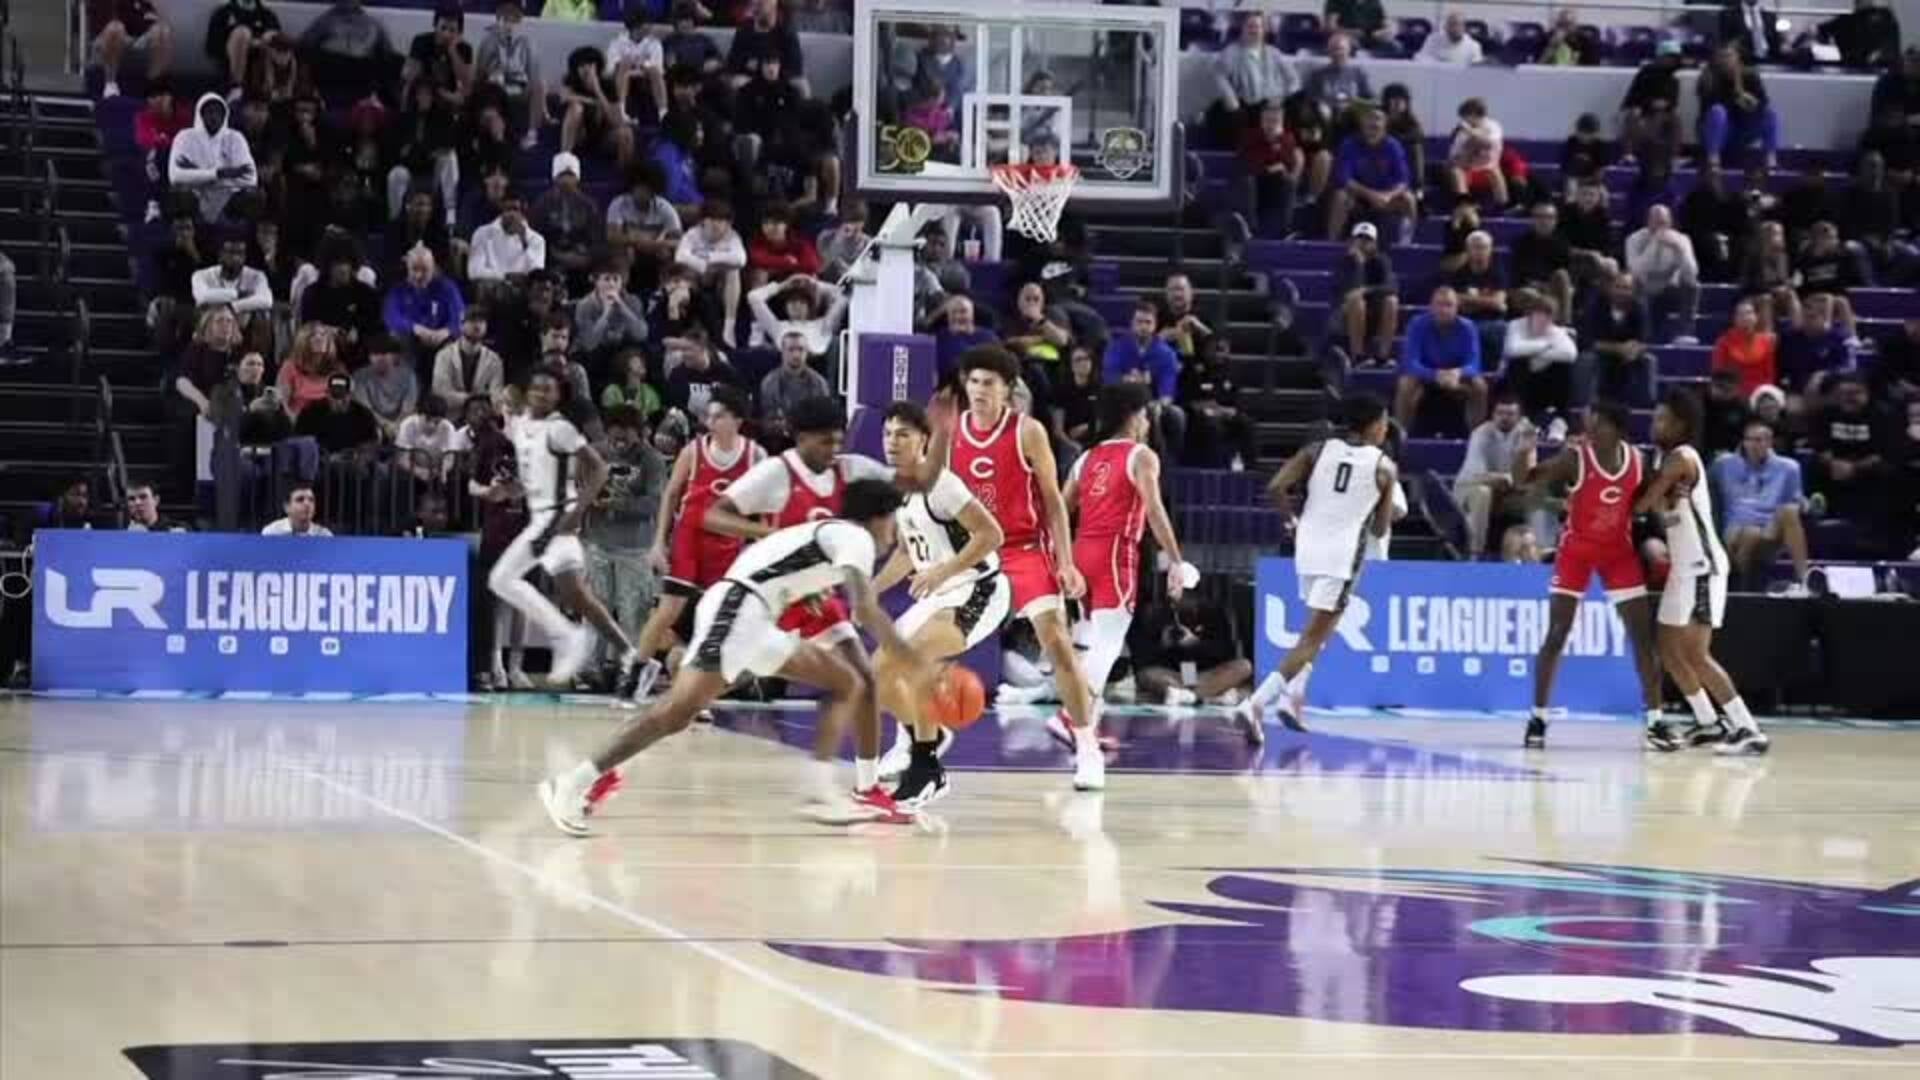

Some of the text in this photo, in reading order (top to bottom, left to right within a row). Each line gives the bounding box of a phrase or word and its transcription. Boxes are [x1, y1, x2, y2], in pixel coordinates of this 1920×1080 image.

[970, 456, 994, 479] C
[1089, 461, 1111, 496] 2
[1334, 462, 1353, 493] 0
[1600, 486, 1622, 504] C
[186, 570, 457, 634] LEAGUEREADY
